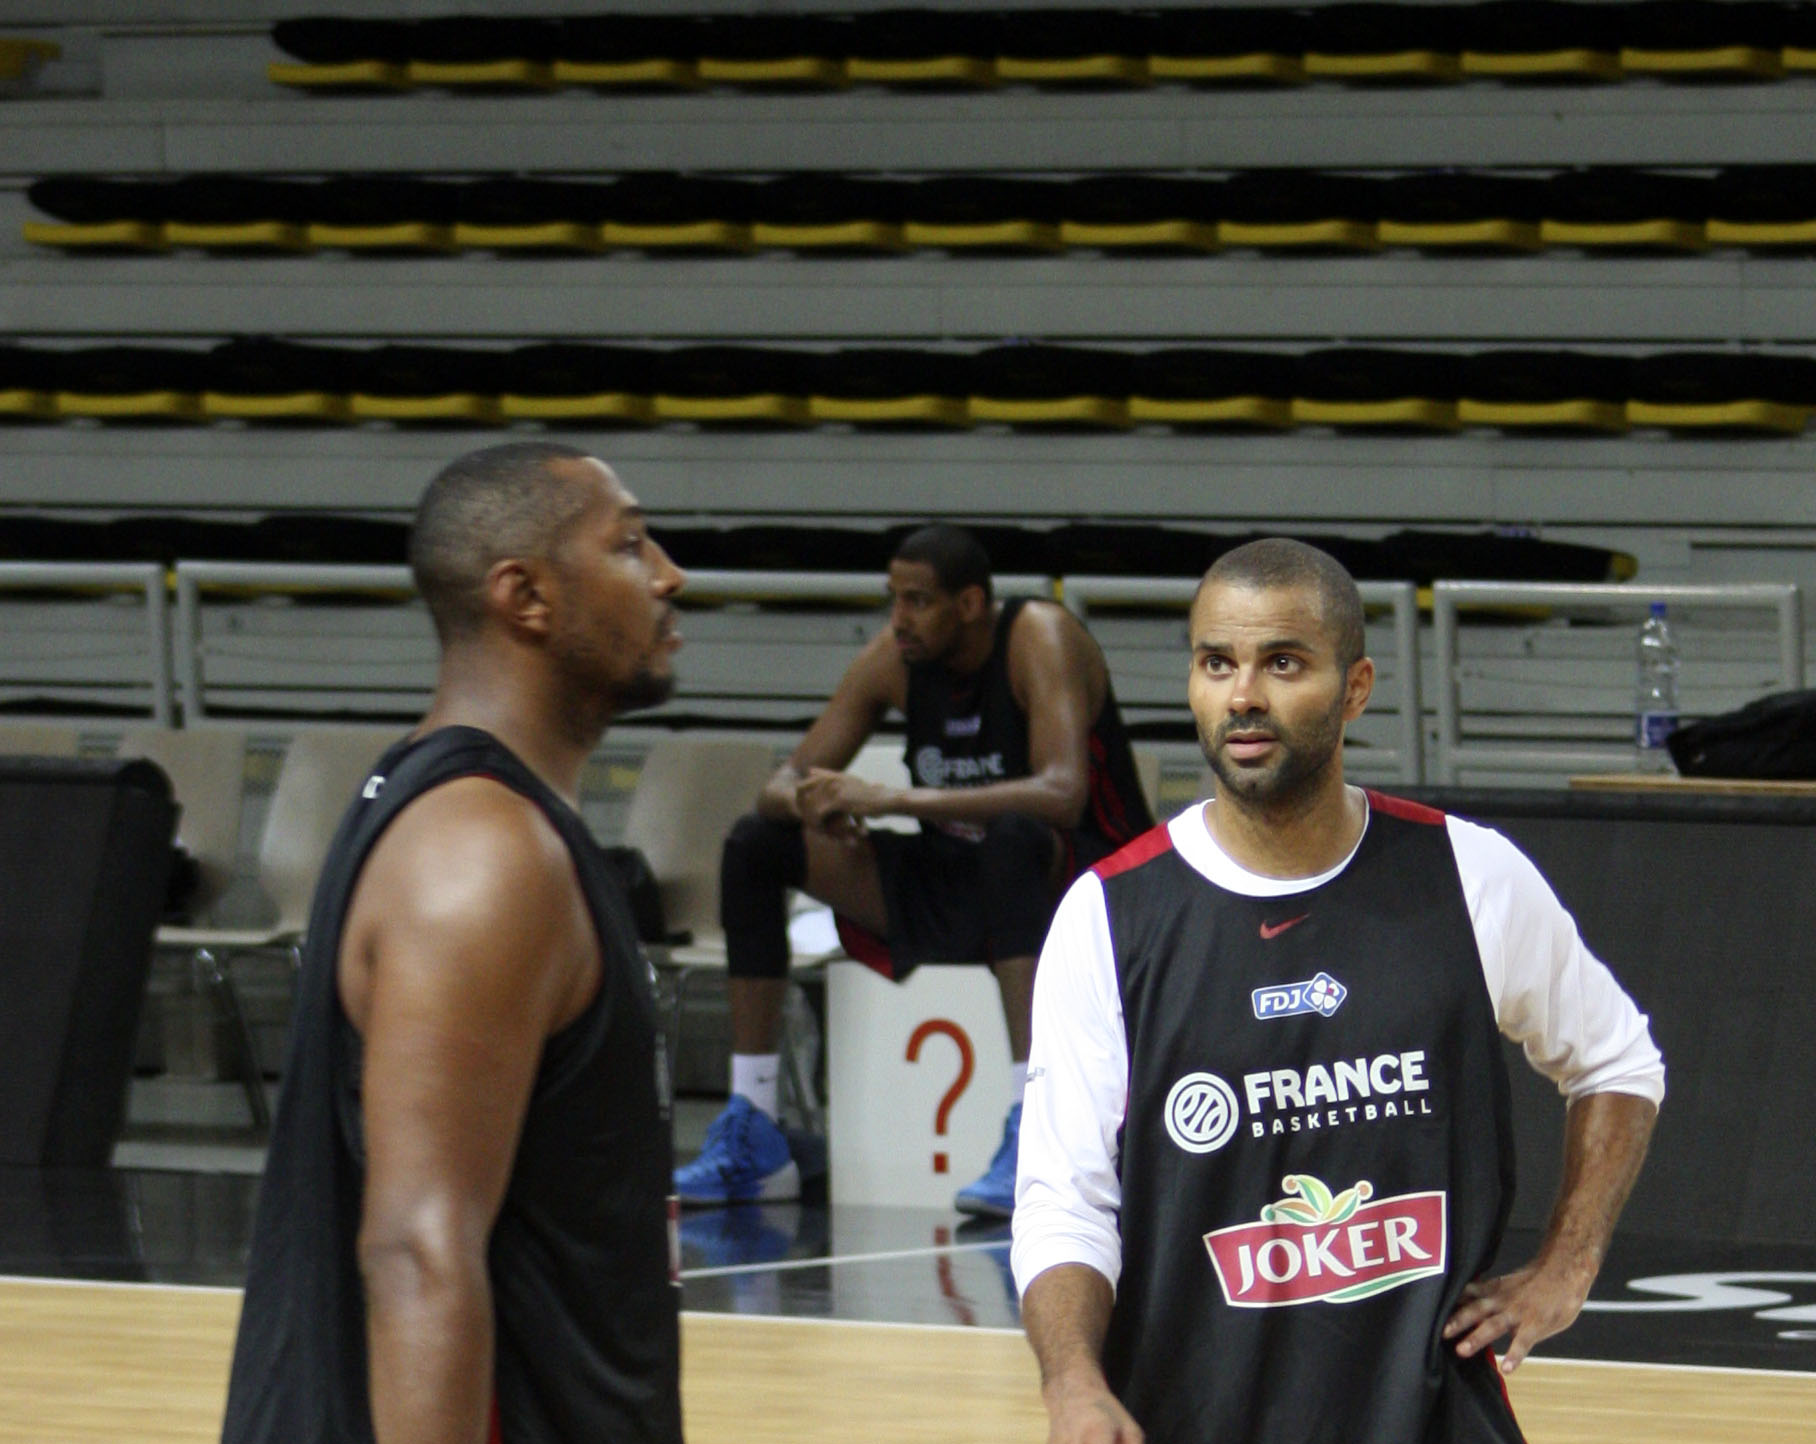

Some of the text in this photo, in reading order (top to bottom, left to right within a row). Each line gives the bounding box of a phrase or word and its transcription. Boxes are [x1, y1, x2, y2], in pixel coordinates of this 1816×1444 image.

[1260, 989, 1301, 1013] FDJ
[1243, 1050, 1429, 1114] FRANCE
[1252, 1098, 1431, 1138] BASKETBALL
[1237, 1216, 1432, 1295] JOKER
